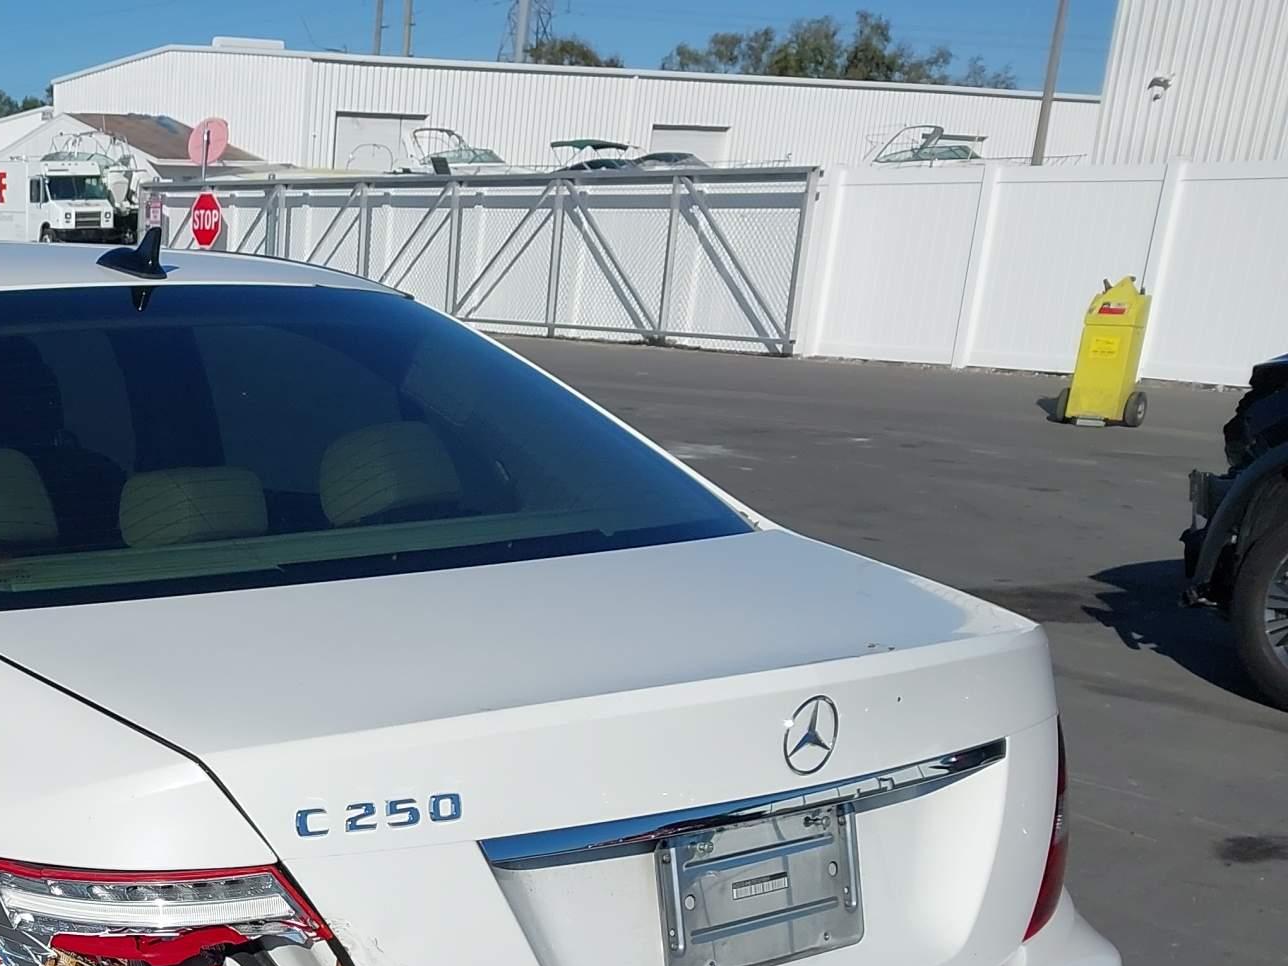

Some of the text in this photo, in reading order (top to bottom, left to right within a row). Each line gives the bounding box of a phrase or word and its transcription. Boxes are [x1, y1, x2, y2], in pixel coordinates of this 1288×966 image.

[193, 209, 219, 231] STOP
[295, 792, 463, 838] C 250
